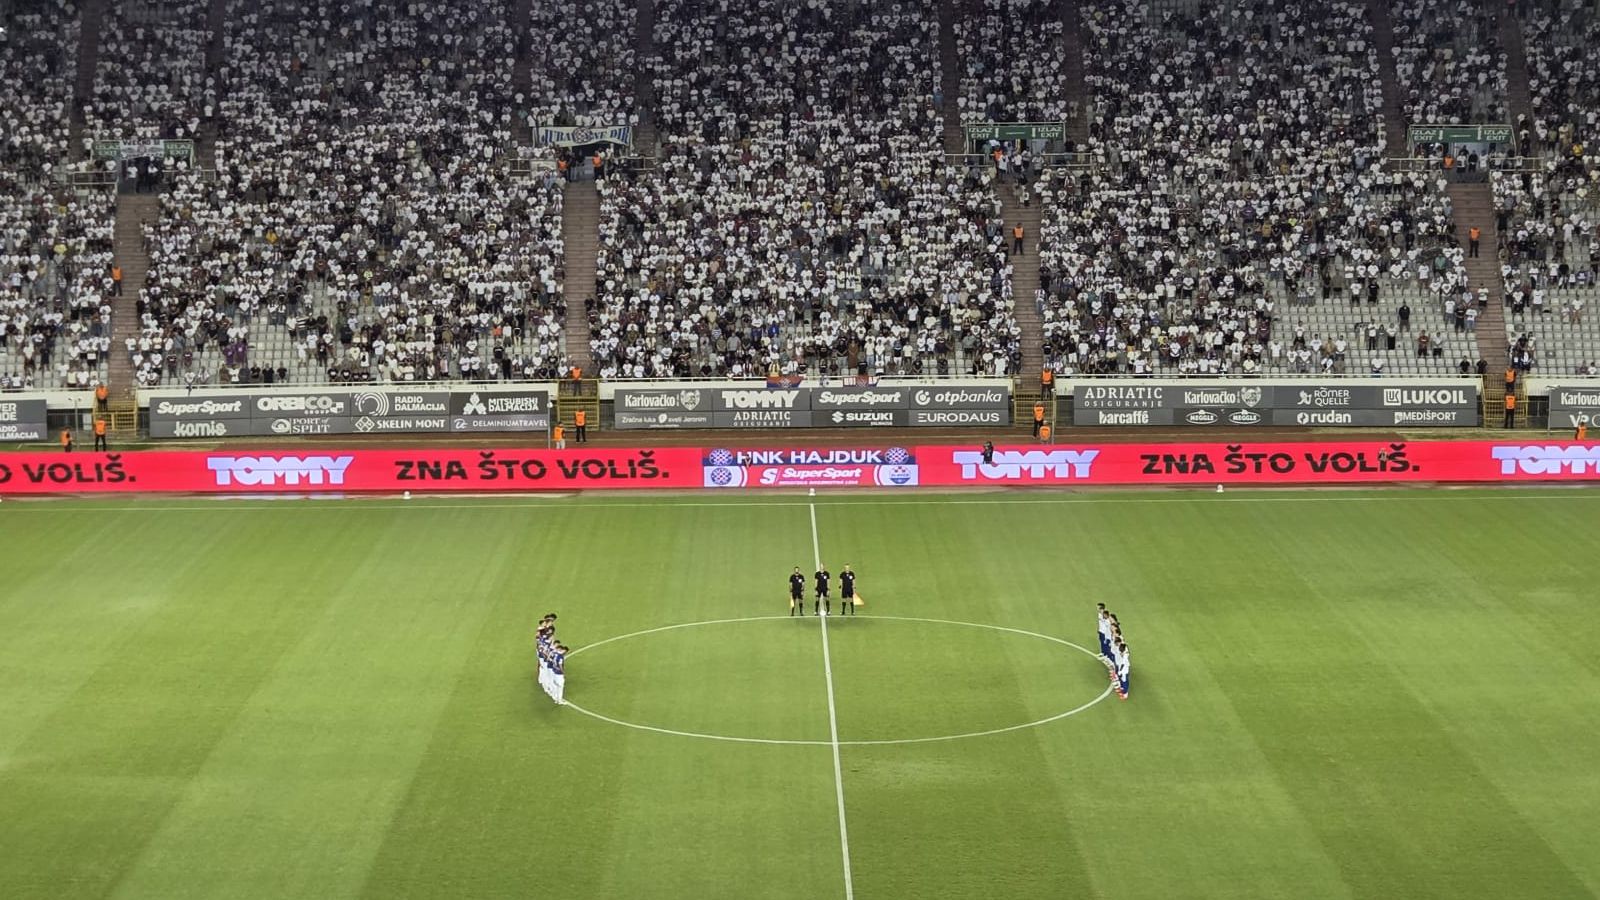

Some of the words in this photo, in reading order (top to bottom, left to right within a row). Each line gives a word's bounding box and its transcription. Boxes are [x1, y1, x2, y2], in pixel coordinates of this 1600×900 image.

[819, 391, 901, 405] SuperSport
[935, 389, 1002, 405] otpbanka
[1085, 387, 1163, 399] ADRIATIC
[1184, 391, 1236, 405] Karlovačko
[1403, 390, 1467, 404] LUKOIL
[257, 396, 333, 411] ORBICO
[395, 396, 424, 404] RADIO
[488, 397, 539, 405] MITSUBISHI
[625, 393, 676, 408] Karlovačko
[721, 390, 799, 409] TOMMY
[1084, 400, 1163, 408] OSIGURANJE
[1314, 397, 1350, 406] QUELLE
[0, 403, 17, 412] ER
[157, 400, 242, 416] SuperSport
[395, 403, 446, 412] DALMACIJA
[488, 404, 540, 412] DALMACIJA
[0, 411, 17, 421] DE
[734, 411, 791, 421] ADRIATIC
[846, 412, 893, 421] SUZUKI
[918, 412, 1000, 423] EURODAUS
[1311, 410, 1352, 423] rudan
[1402, 410, 1457, 421] MEDIŠPORT
[174, 420, 227, 436] komis
[292, 424, 331, 434] SPLIT
[377, 419, 413, 430] SKELIN
[415, 419, 446, 429] MONT
[472, 419, 548, 427] DELMINIUMTRAVEL
[737, 450, 783, 465] HNK
[791, 450, 882, 464] HAJDUK
[1140, 454, 1215, 474] ZNA
[1224, 444, 1296, 474] ŠTO
[1305, 443, 1420, 473] VOLIŠ.
[22, 454, 136, 483] VOLIŠ.
[395, 460, 468, 481] ZNA
[479, 451, 547, 481] ŠTO
[556, 450, 670, 480] VOLIŠ.
[952, 450, 1101, 479] TOMMY
[206, 456, 355, 486] TOMMY
[782, 467, 862, 479] SuperSport
